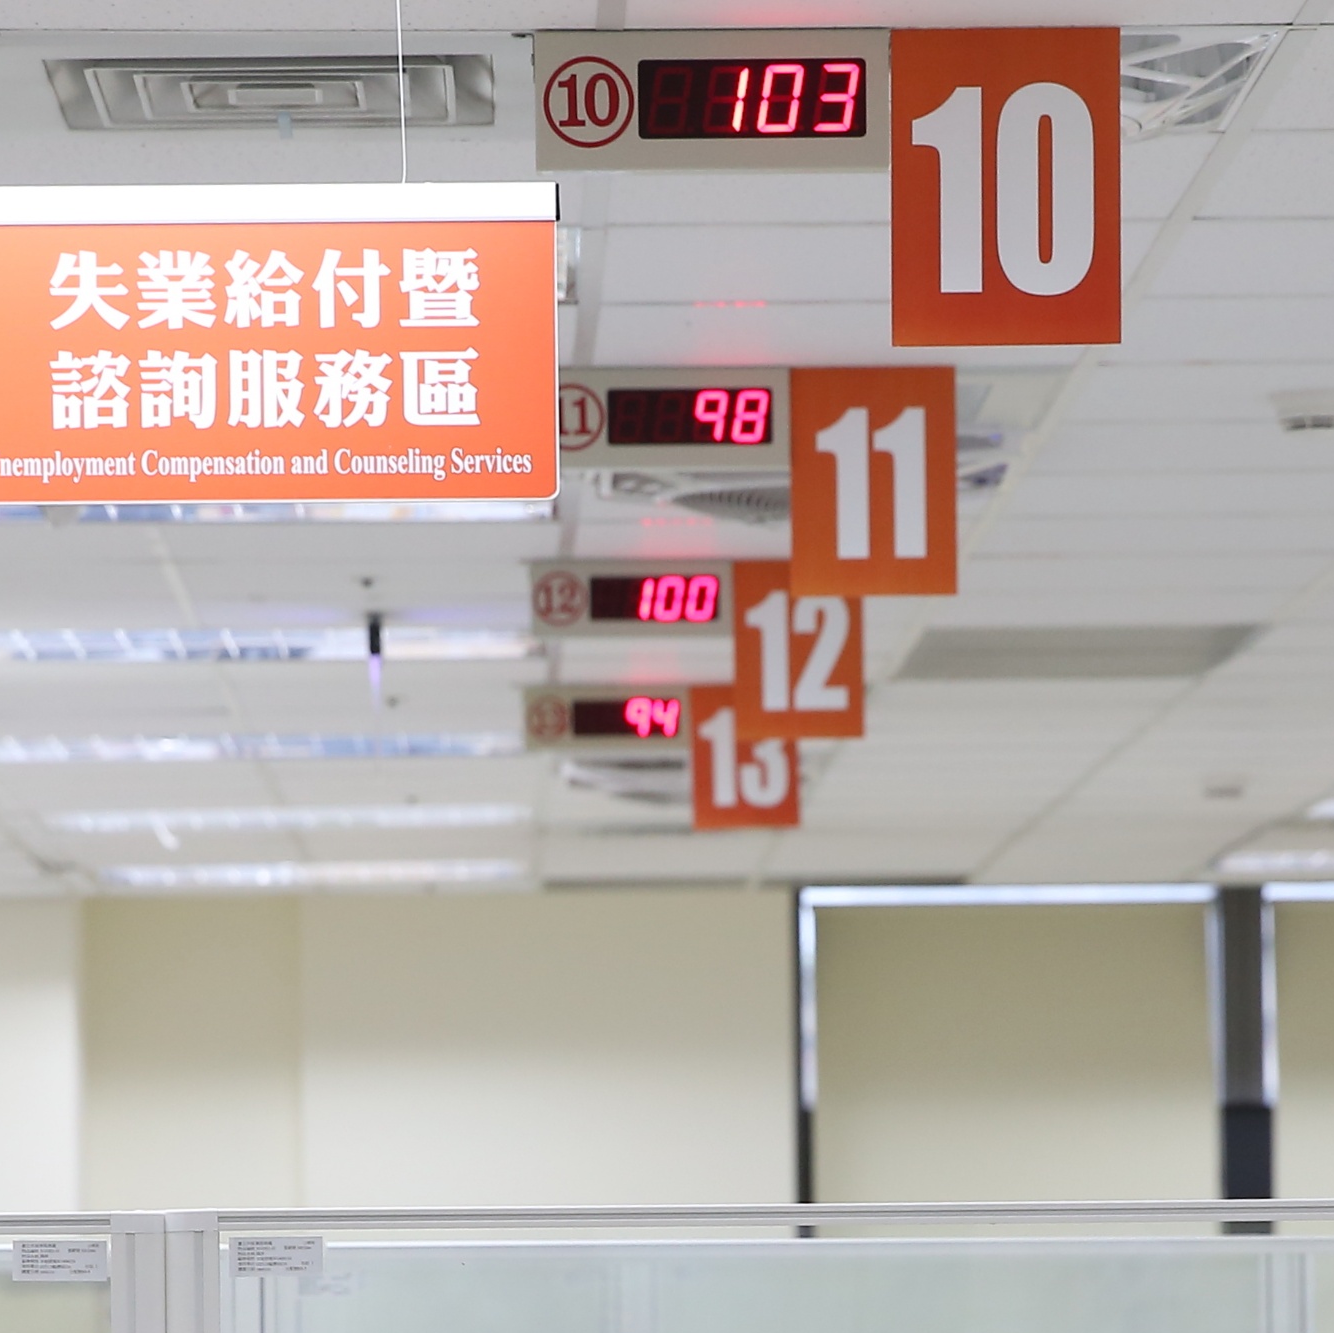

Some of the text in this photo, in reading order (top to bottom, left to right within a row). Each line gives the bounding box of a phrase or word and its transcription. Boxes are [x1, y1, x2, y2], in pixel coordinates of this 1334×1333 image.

[557, 73, 620, 127] 10
[731, 63, 861, 133] 103
[911, 82, 1095, 296] 10
[49, 247, 481, 331] 失業給付暨
[49, 347, 482, 430] 諮詢服務區
[694, 388, 770, 445] 98
[140, 449, 285, 483] Compensation
[290, 449, 329, 475] and
[334, 448, 446, 481] Counseling
[450, 447, 532, 474] Services
[815, 406, 927, 560] 11
[638, 575, 720, 624] 100
[745, 589, 850, 713] 12
[624, 695, 681, 739] 94
[698, 707, 789, 809] 13
